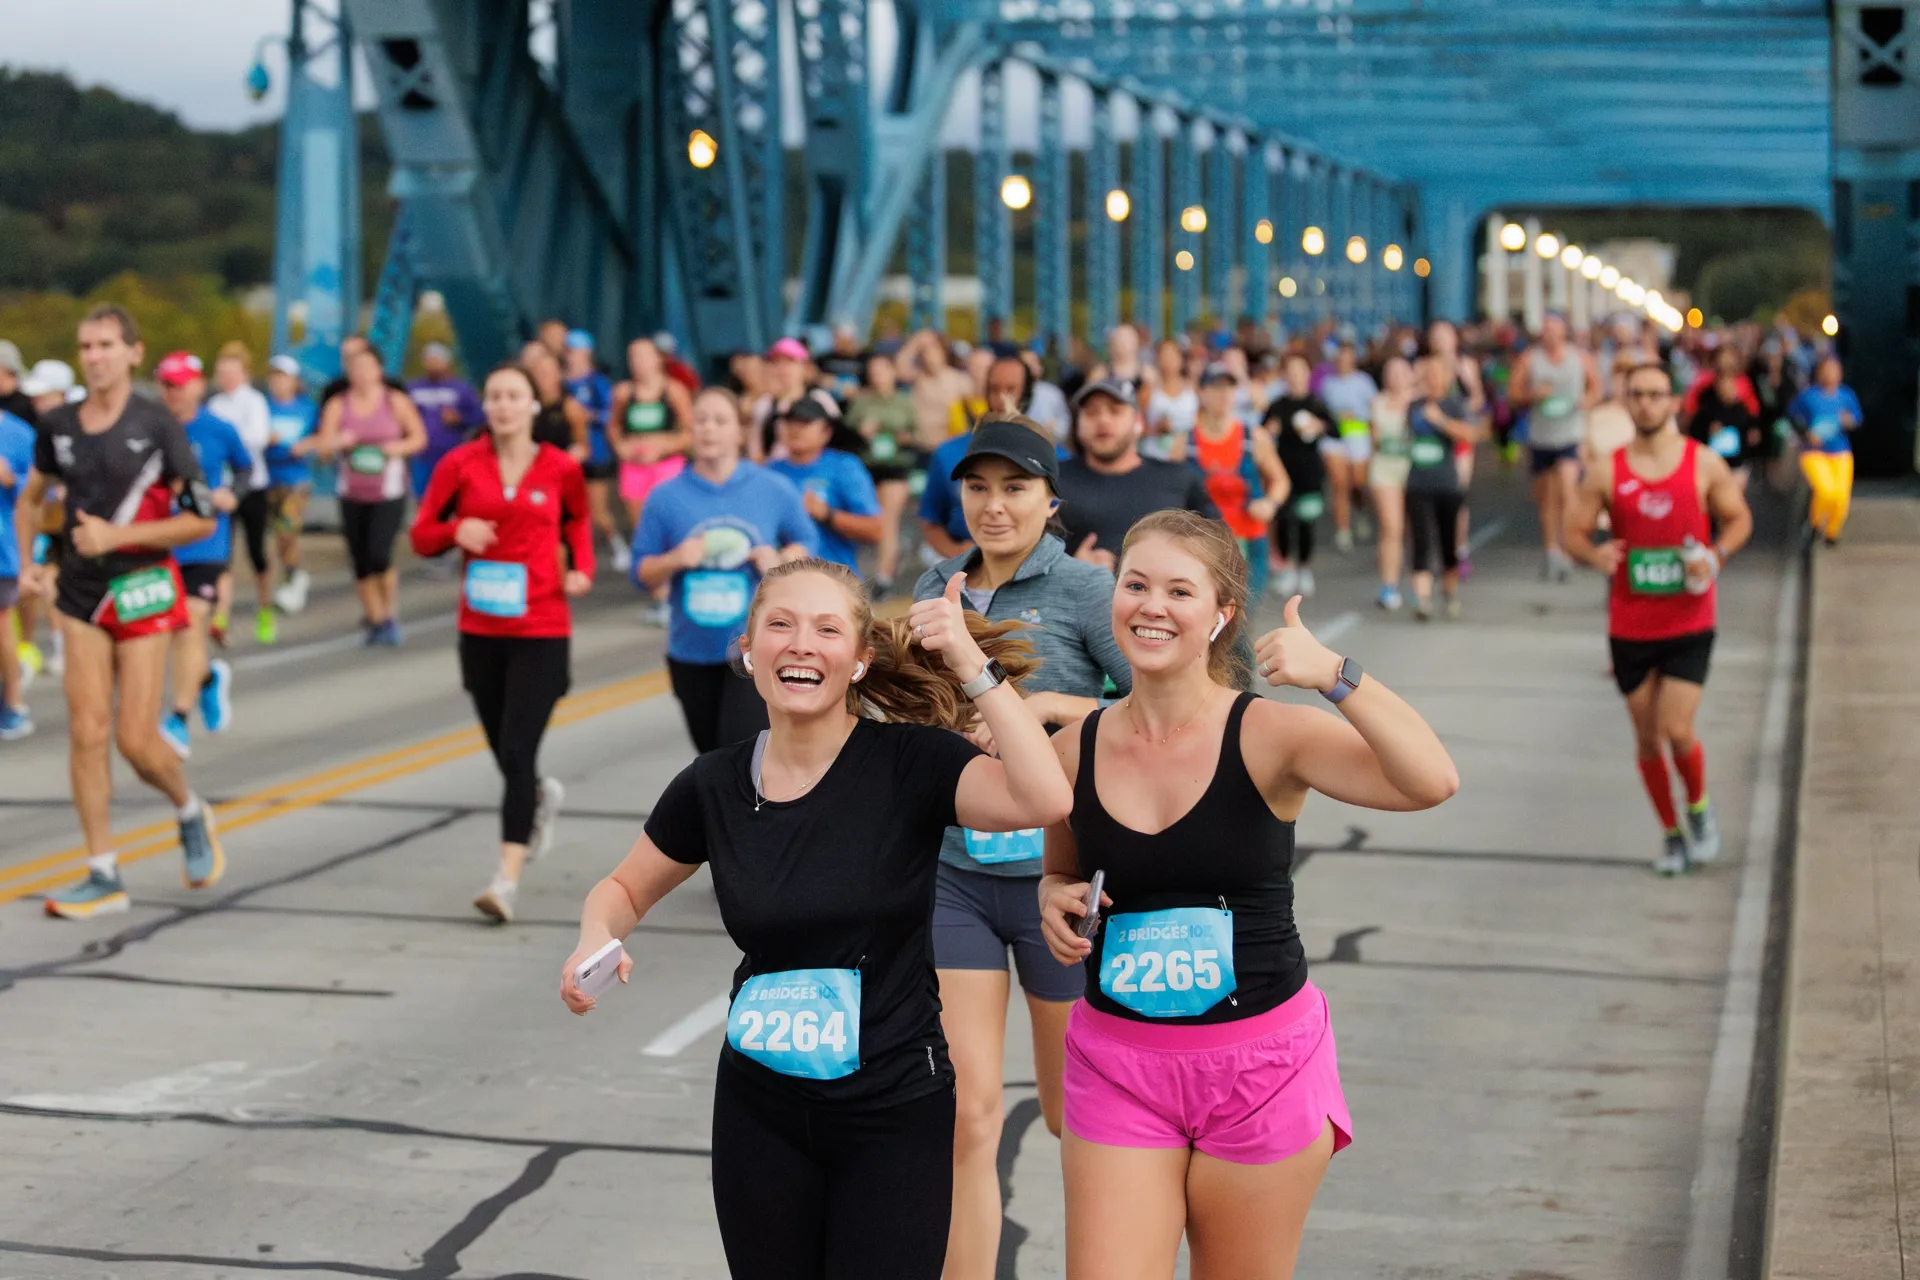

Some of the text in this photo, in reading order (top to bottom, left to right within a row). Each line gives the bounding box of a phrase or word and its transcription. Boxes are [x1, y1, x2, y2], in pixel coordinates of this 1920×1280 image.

[1119, 930, 1127, 943] 2
[1128, 925, 1188, 941] BRIDGES
[1111, 949, 1222, 993] 2265
[748, 990, 758, 1001] 2
[760, 986, 818, 1001] BRIDGES
[738, 1010, 847, 1052] 2264
